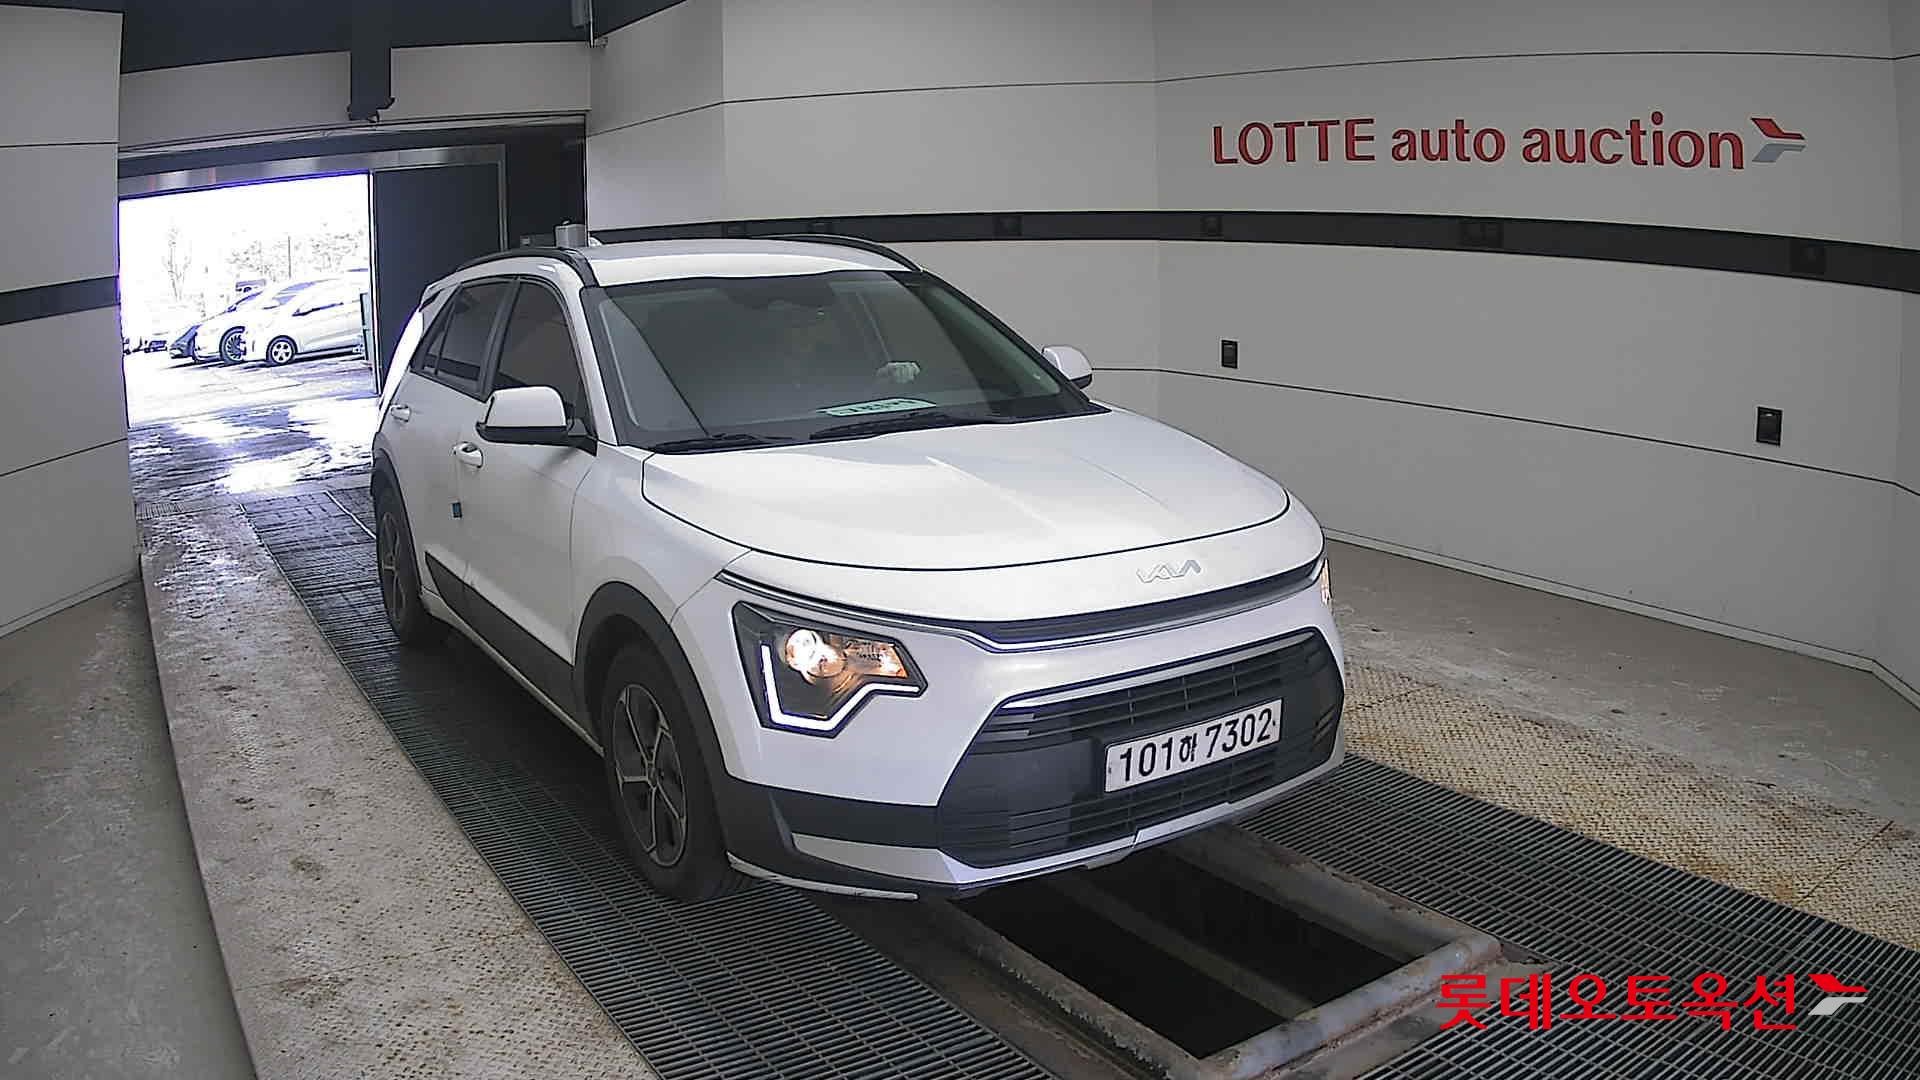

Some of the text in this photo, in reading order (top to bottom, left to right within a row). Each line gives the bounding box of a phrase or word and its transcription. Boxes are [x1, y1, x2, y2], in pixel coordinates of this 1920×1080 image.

[1212, 111, 1745, 169] LOTTE auto auction
[1205, 708, 1273, 758] 7302
